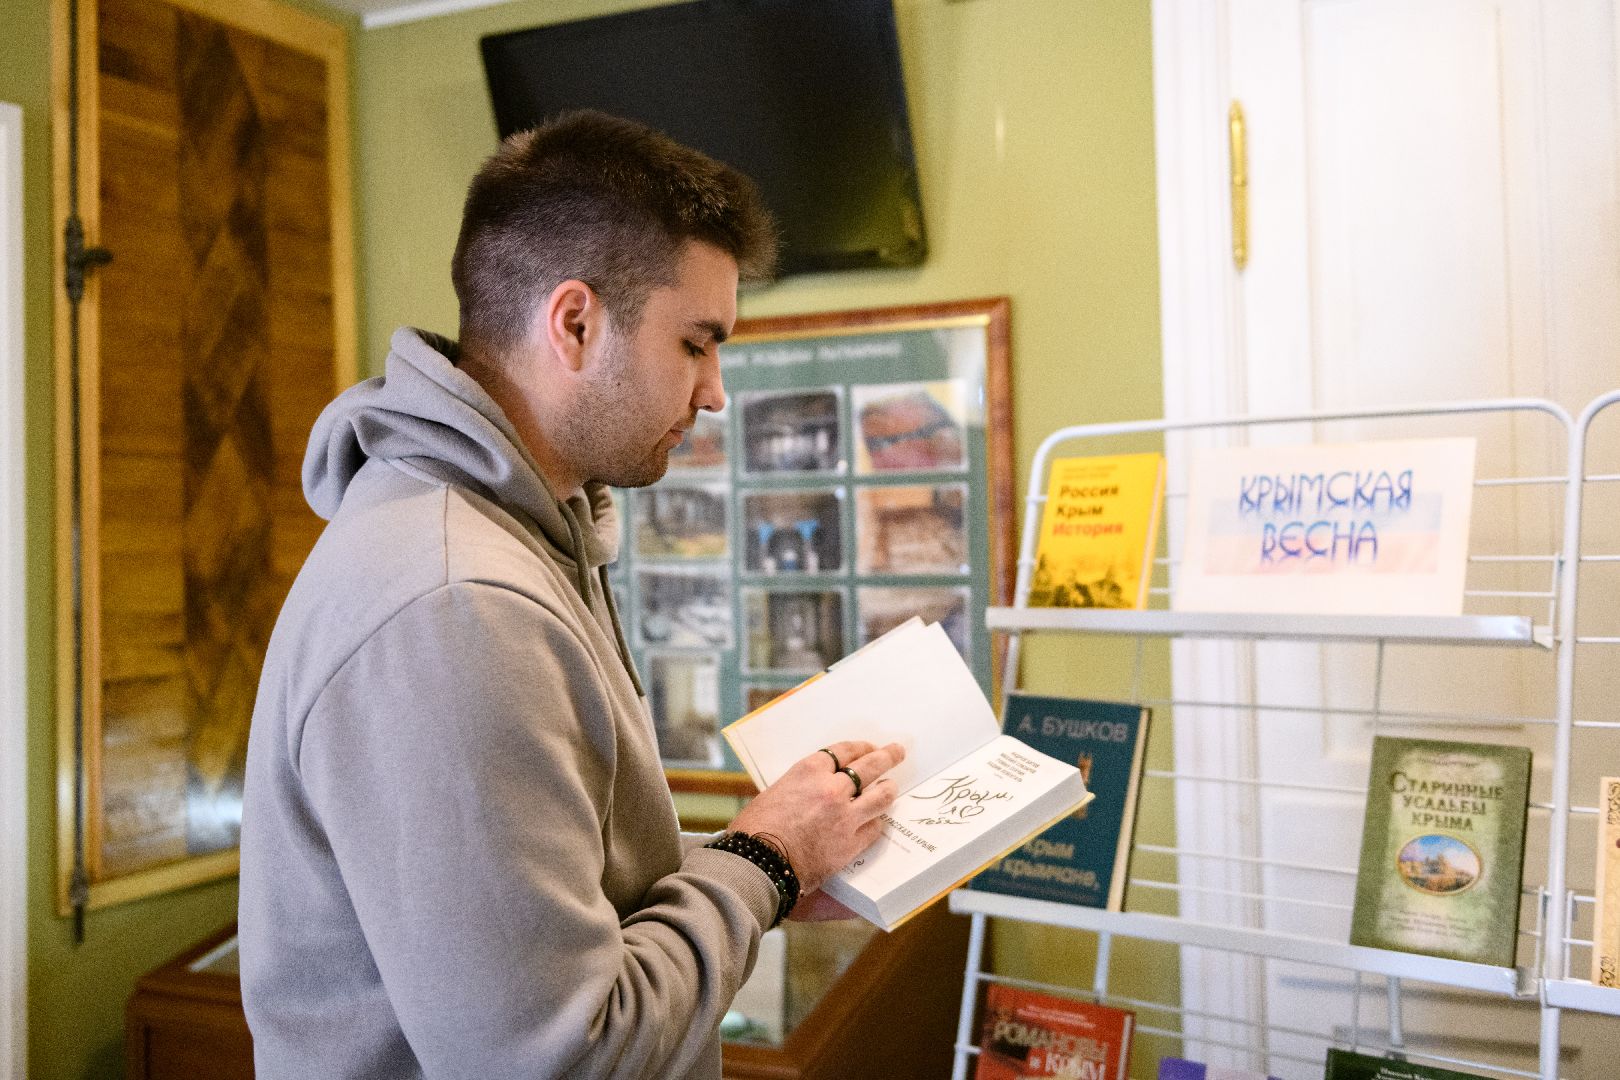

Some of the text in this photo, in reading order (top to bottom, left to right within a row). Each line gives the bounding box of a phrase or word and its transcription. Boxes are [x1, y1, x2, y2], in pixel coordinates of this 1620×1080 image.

[1060, 485, 1119, 498] Россия
[1239, 470, 1413, 514] КРЫМСКАЯ
[1057, 504, 1104, 519] Крым
[1053, 523, 1123, 538] История
[1262, 520, 1378, 561] ВЕСНА
[1041, 715, 1128, 742] БУШКОВ
[1390, 771, 1504, 799] СТАРИННЫЕ
[1402, 795, 1487, 816] УСАДЬБЫ
[884, 817, 914, 838] РАССКАЗА
[1411, 812, 1474, 832] КРЫМА
